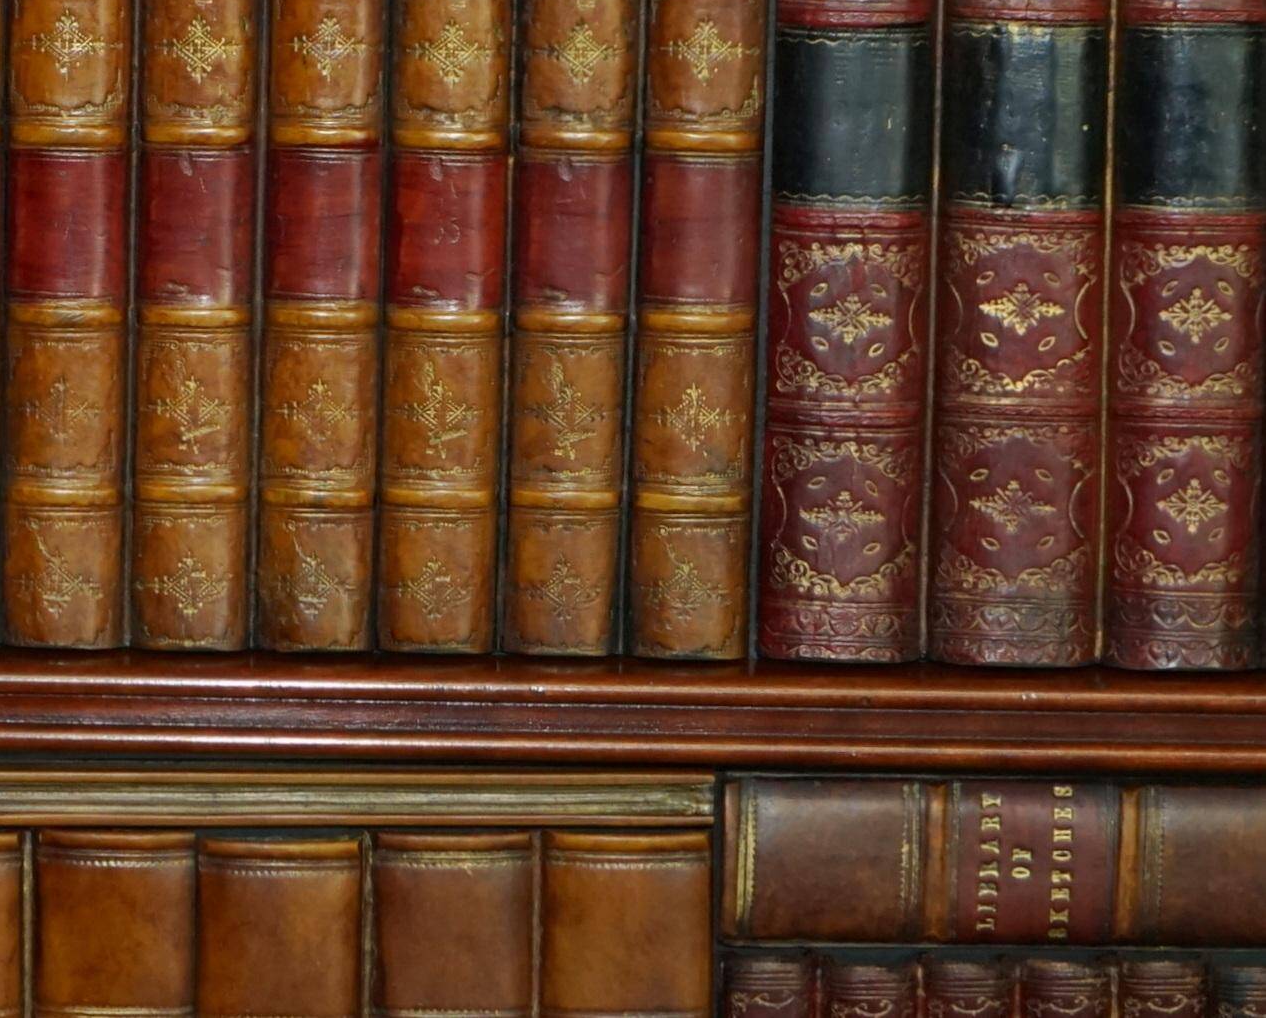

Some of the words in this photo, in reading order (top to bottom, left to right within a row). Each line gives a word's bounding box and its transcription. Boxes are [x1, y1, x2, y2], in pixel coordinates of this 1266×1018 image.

[976, 793, 1001, 931] LIBRARY
[1012, 848, 1032, 879] OF
[1048, 786, 1073, 938] SKETCHES
